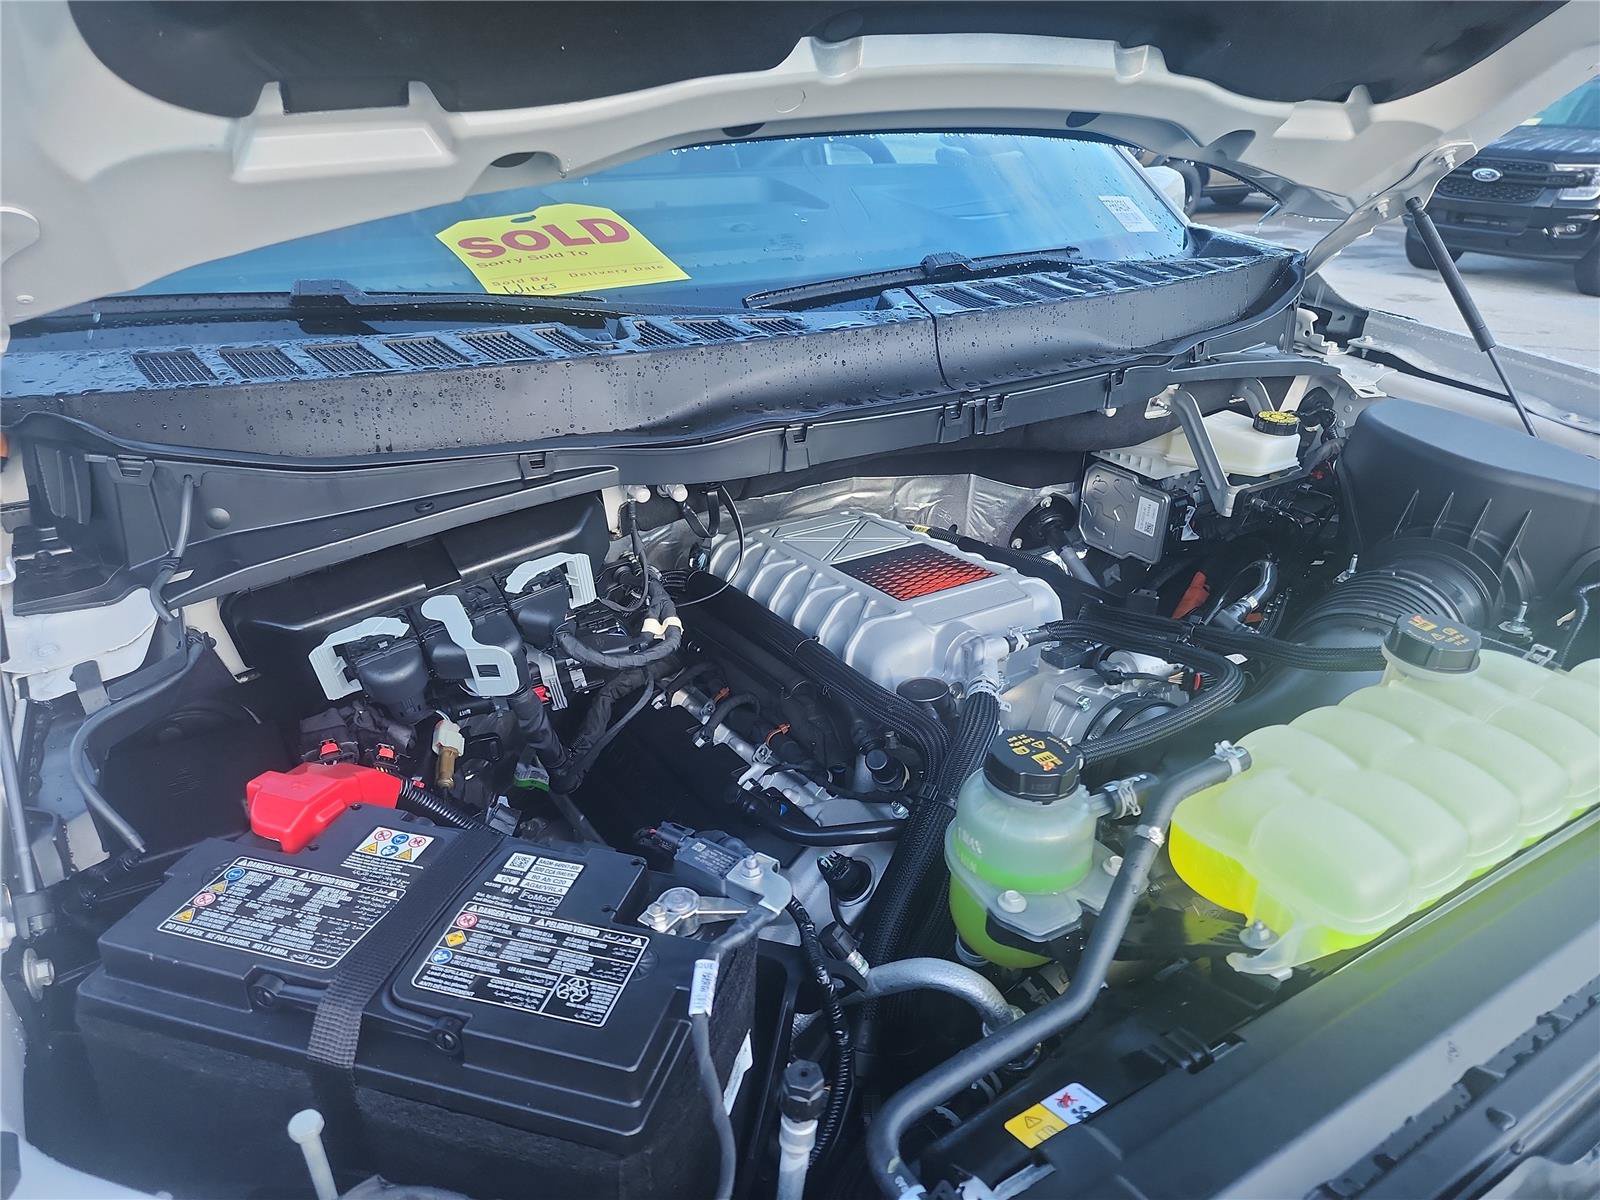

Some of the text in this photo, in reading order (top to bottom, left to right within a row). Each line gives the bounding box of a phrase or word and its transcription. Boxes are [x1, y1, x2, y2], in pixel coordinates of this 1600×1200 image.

[457, 218, 630, 259] SOLD
[476, 249, 589, 269] Sorry Sold To
[492, 264, 664, 287] Sold By Delivery Date
[501, 885, 521, 895] MF
[521, 891, 560, 905] FoMoCo
